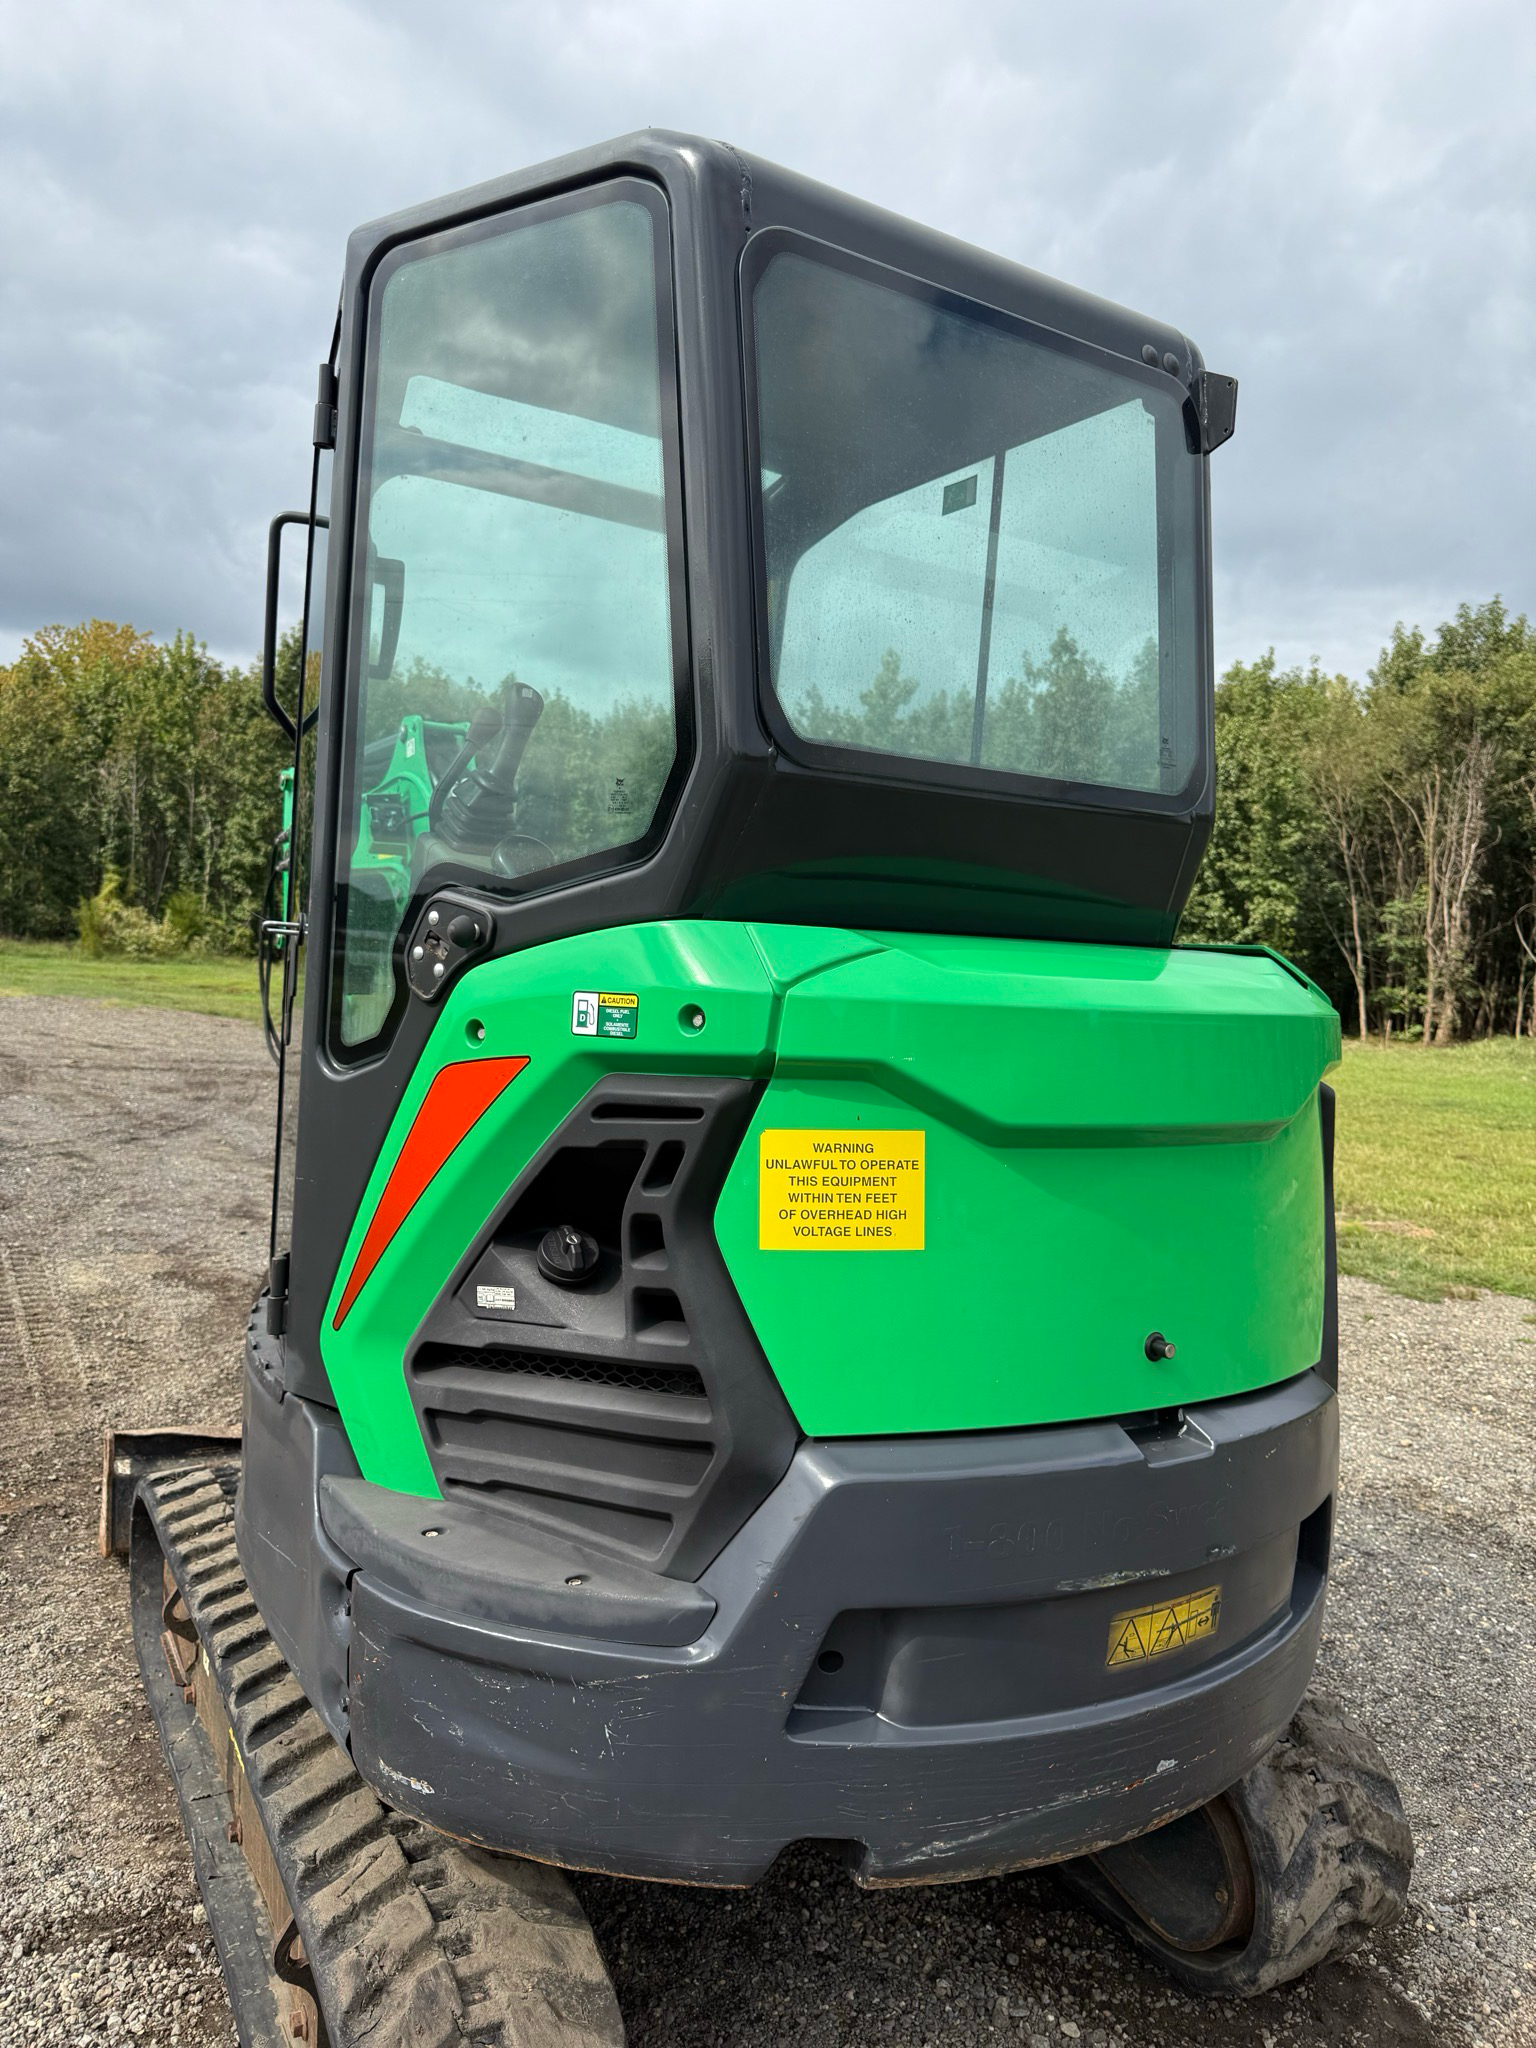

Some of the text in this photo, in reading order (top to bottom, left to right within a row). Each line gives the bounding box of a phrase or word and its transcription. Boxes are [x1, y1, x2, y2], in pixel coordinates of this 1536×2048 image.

[813, 1143, 874, 1154] WARNING
[765, 1159, 919, 1170] UNLAWFUL TO OPERATE
[789, 1176, 897, 1187] THIS EQUIPMENT
[788, 1193, 897, 1203] WITHIN TEN FEET
[779, 1209, 907, 1220] OF OVERHEAD HIGH
[793, 1226, 892, 1236] VOLTAGE LINES
[548, 1236, 562, 1264] DIESEL
